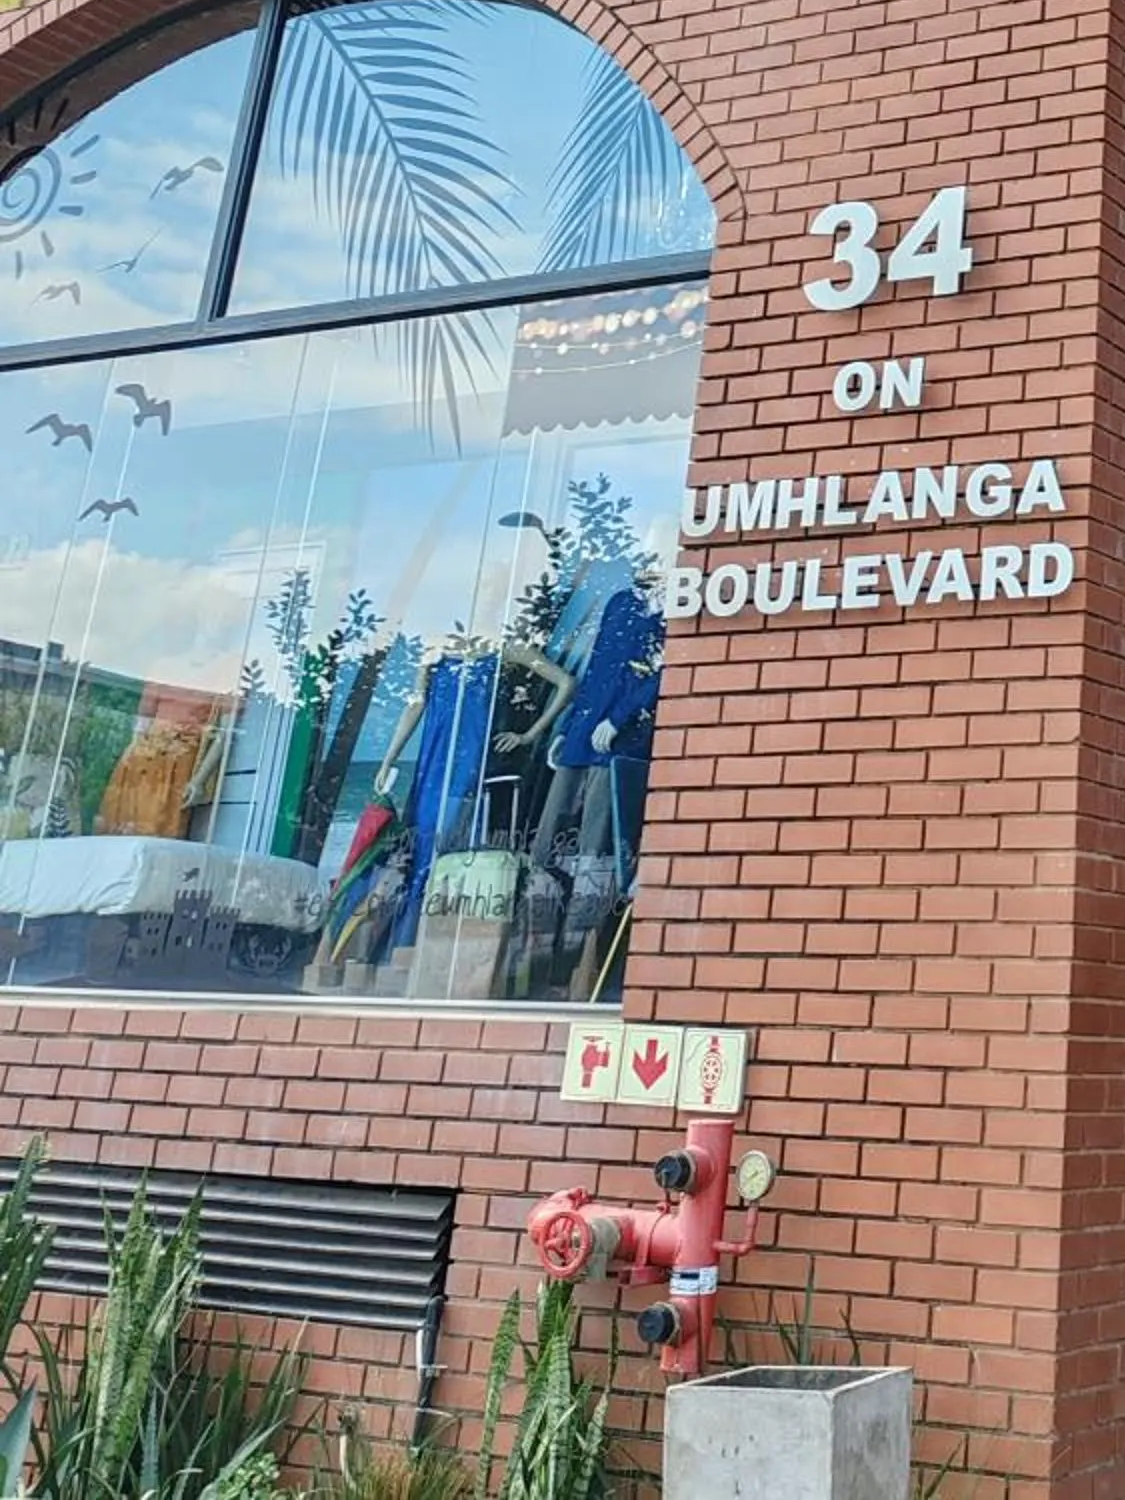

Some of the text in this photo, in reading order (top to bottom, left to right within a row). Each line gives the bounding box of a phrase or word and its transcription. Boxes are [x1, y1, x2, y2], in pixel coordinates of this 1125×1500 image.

[803, 186, 974, 312] 34
[832, 357, 925, 412] ON
[680, 459, 1066, 538] UMHLANGA
[664, 542, 1076, 620] BOULEVARD
